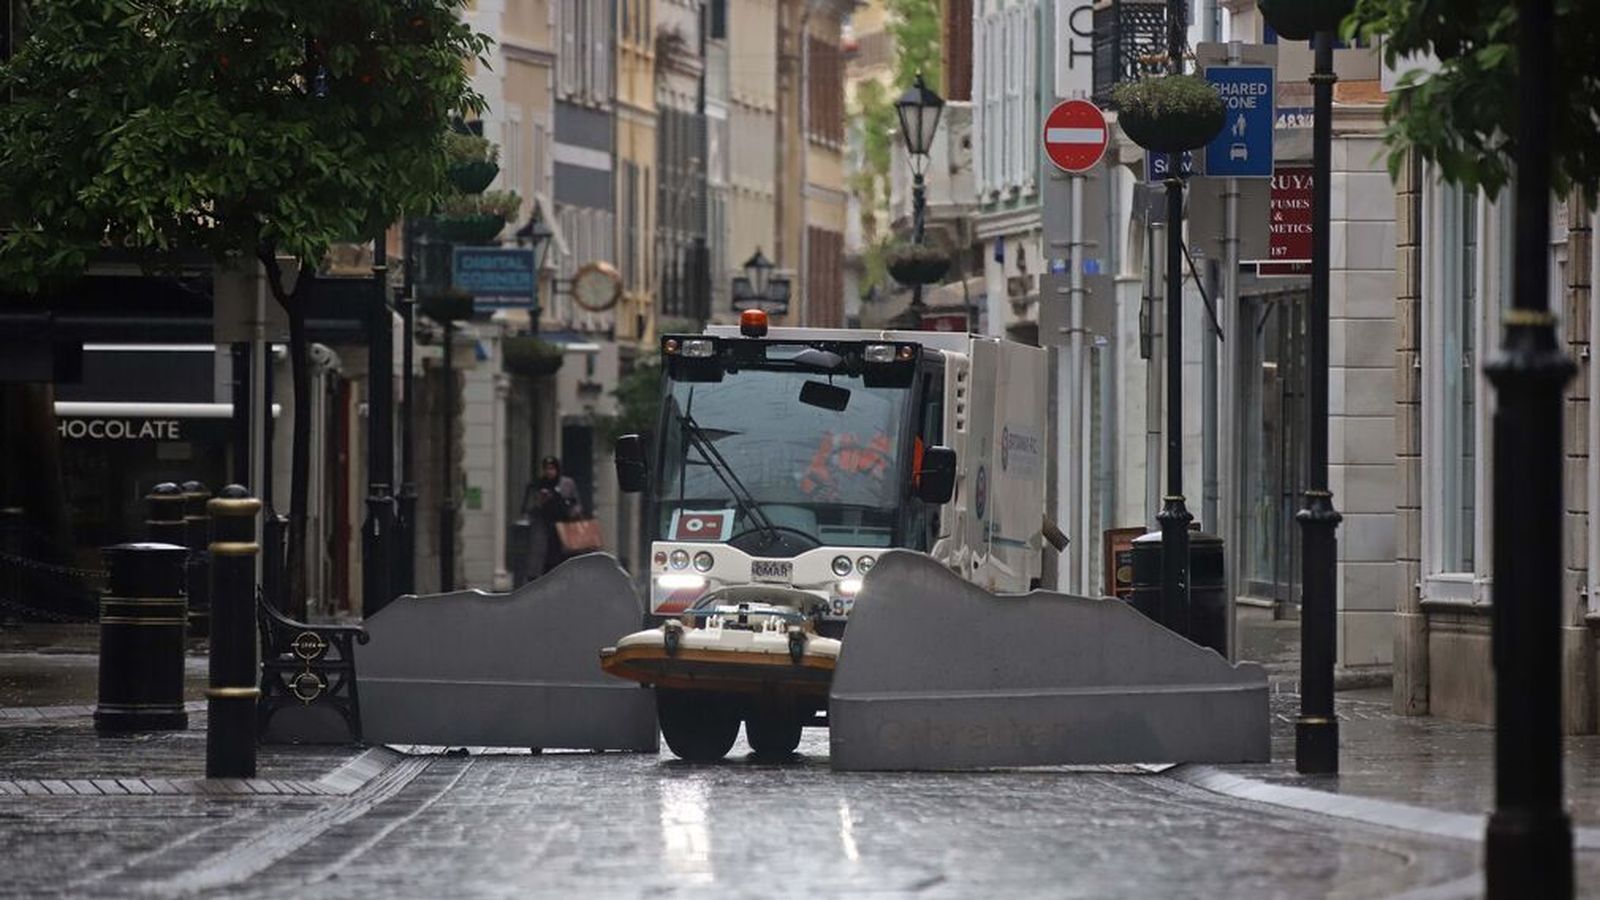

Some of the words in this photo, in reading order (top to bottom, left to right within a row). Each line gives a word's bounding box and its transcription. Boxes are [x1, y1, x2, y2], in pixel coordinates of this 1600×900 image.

[1212, 82, 1267, 95] SHARED
[1273, 211, 1283, 221] &
[1271, 246, 1288, 256] 187
[461, 256, 527, 270] DIGITAL
